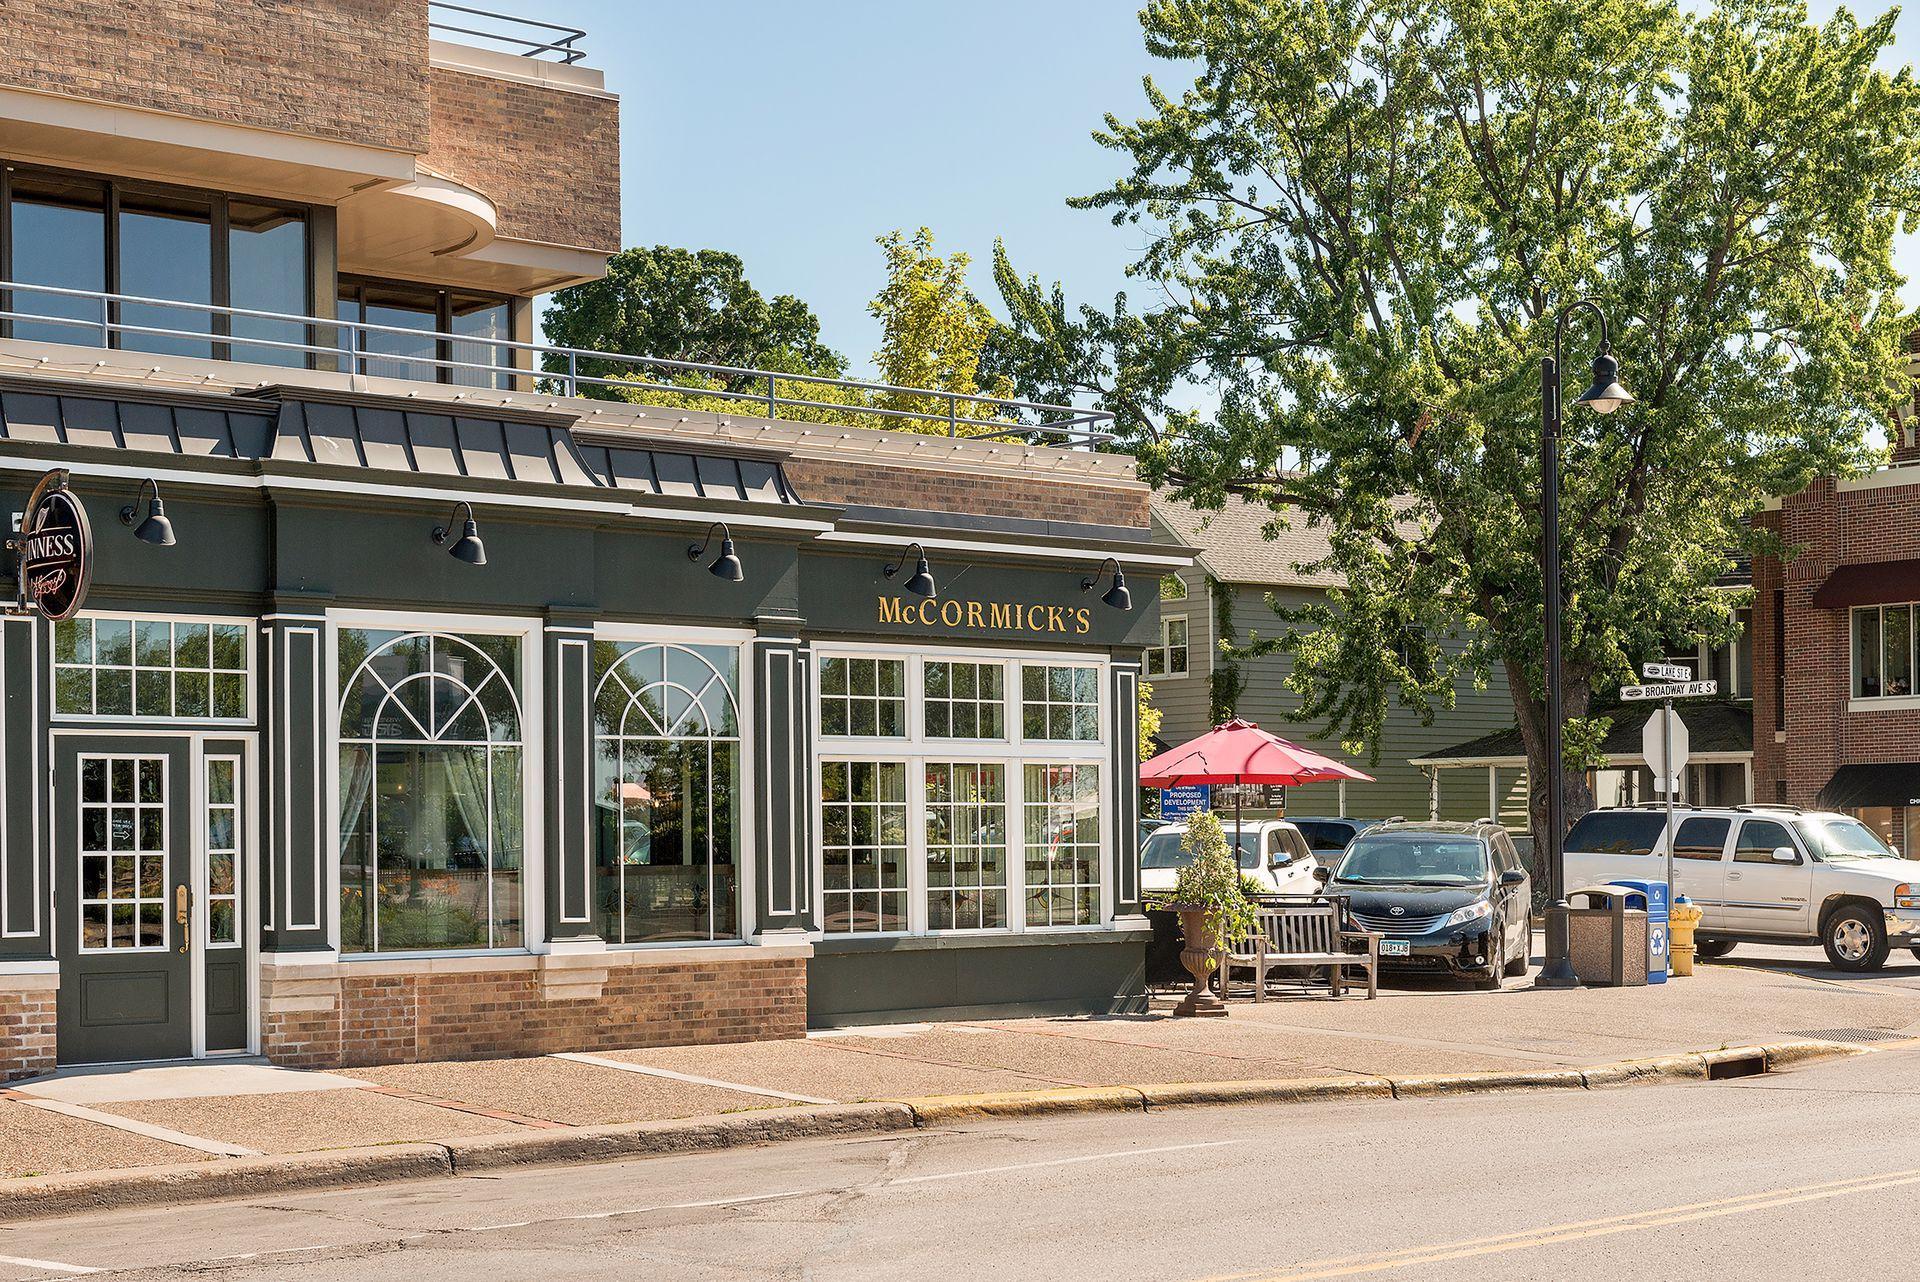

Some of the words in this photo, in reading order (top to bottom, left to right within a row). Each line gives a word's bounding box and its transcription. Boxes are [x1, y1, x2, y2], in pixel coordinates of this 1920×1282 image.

[878, 596, 1090, 634] McCORMICK'S
[1661, 666, 1676, 678] LAKE
[1677, 668, 1684, 678] ST
[1684, 668, 1688, 679] E
[1645, 684, 1685, 697] BROADWAY
[1688, 683, 1703, 694] AVE
[1706, 682, 1712, 693] S
